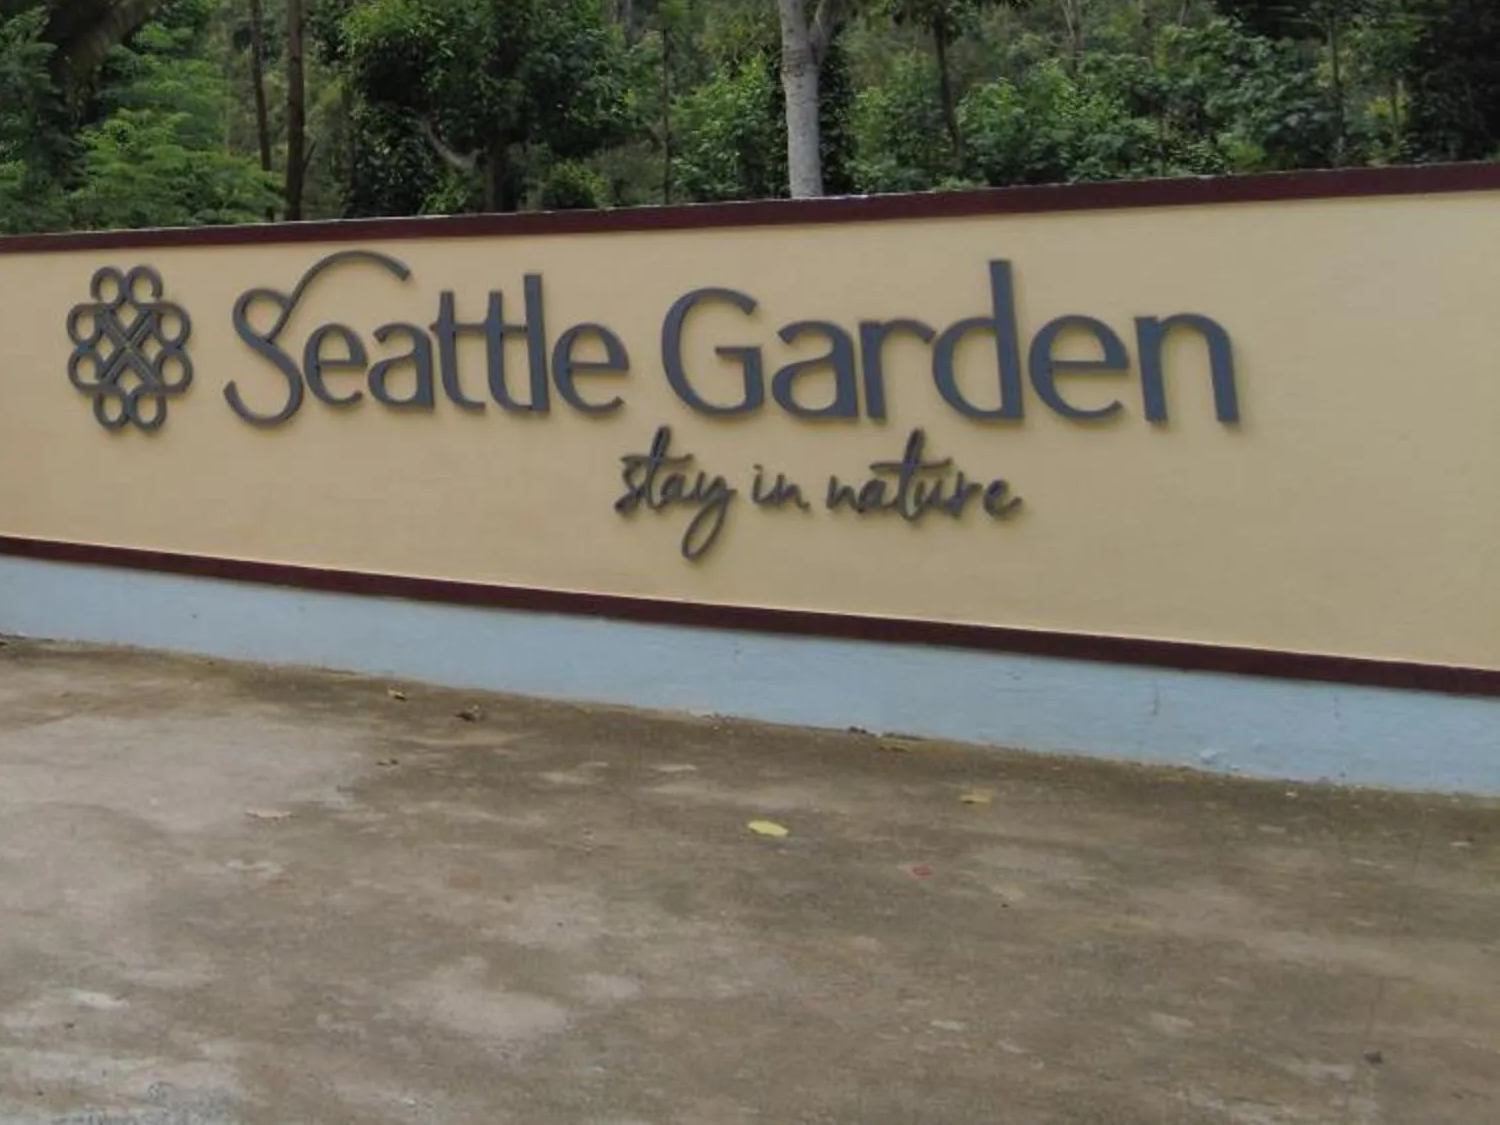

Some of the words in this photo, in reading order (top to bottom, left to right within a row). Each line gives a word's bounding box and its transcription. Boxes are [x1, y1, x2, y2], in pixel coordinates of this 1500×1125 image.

[222, 250, 631, 427] Seattle
[661, 258, 1241, 425] Garden
[614, 425, 736, 562] stay
[751, 462, 808, 512] in
[825, 427, 1022, 523] nature
